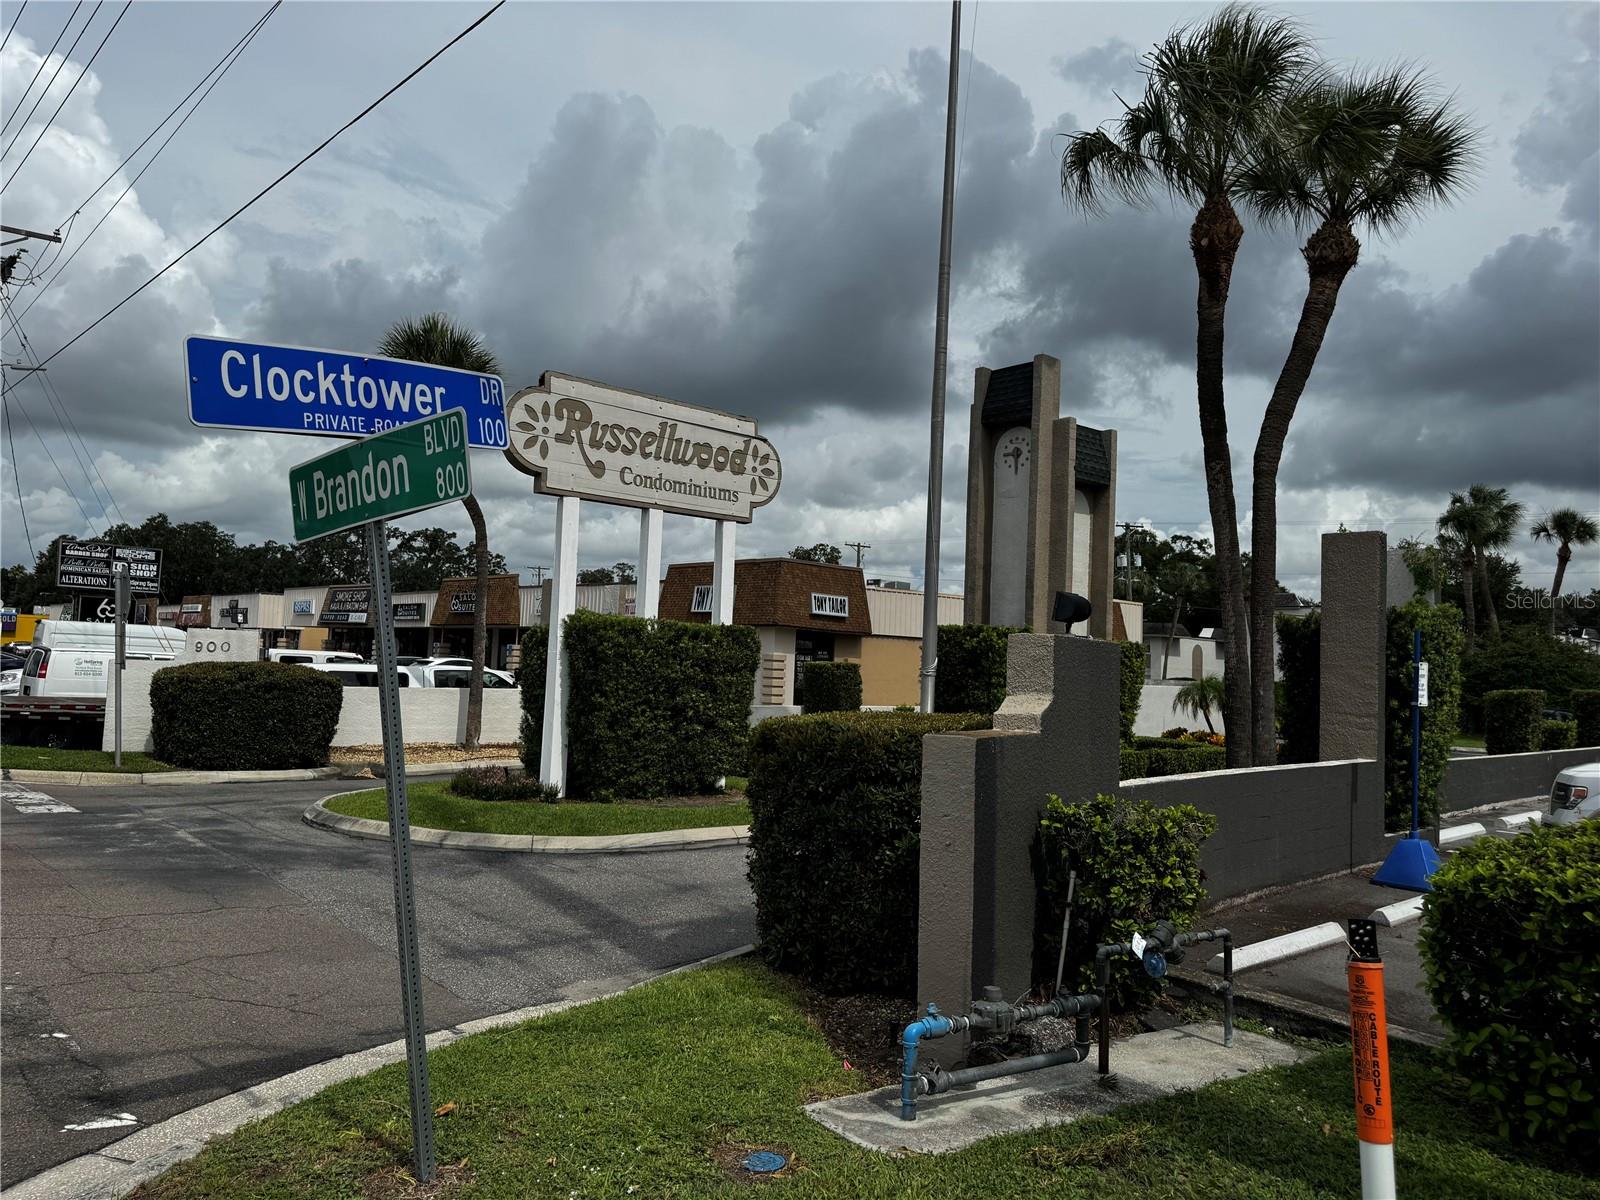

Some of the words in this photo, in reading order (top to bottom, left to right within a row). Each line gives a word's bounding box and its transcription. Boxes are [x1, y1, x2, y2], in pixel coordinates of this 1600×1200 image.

[221, 350, 446, 415] Clocktower
[480, 377, 500, 406] DR
[303, 412, 367, 433] PRIVATE
[375, 418, 409, 433] RO
[478, 418, 505, 446] 100
[554, 398, 751, 479] Russellwood
[297, 479, 308, 521] W
[313, 450, 410, 520] Brandon
[424, 415, 460, 456] BLVD
[436, 461, 466, 499] 800
[619, 466, 739, 503] Condominiums
[60, 565, 91, 573] DOMINICAN
[130, 563, 157, 571] SIGN
[61, 574, 107, 586] ALTERATIONS
[458, 603, 476, 611] SUITE
[459, 592, 476, 601] SALO
[813, 595, 828, 613] TONY
[828, 596, 847, 615] TAILOR
[195, 641, 231, 652] 900
[1369, 1012, 1379, 1058] CABLE
[1372, 1061, 1382, 1106] ROUTE
